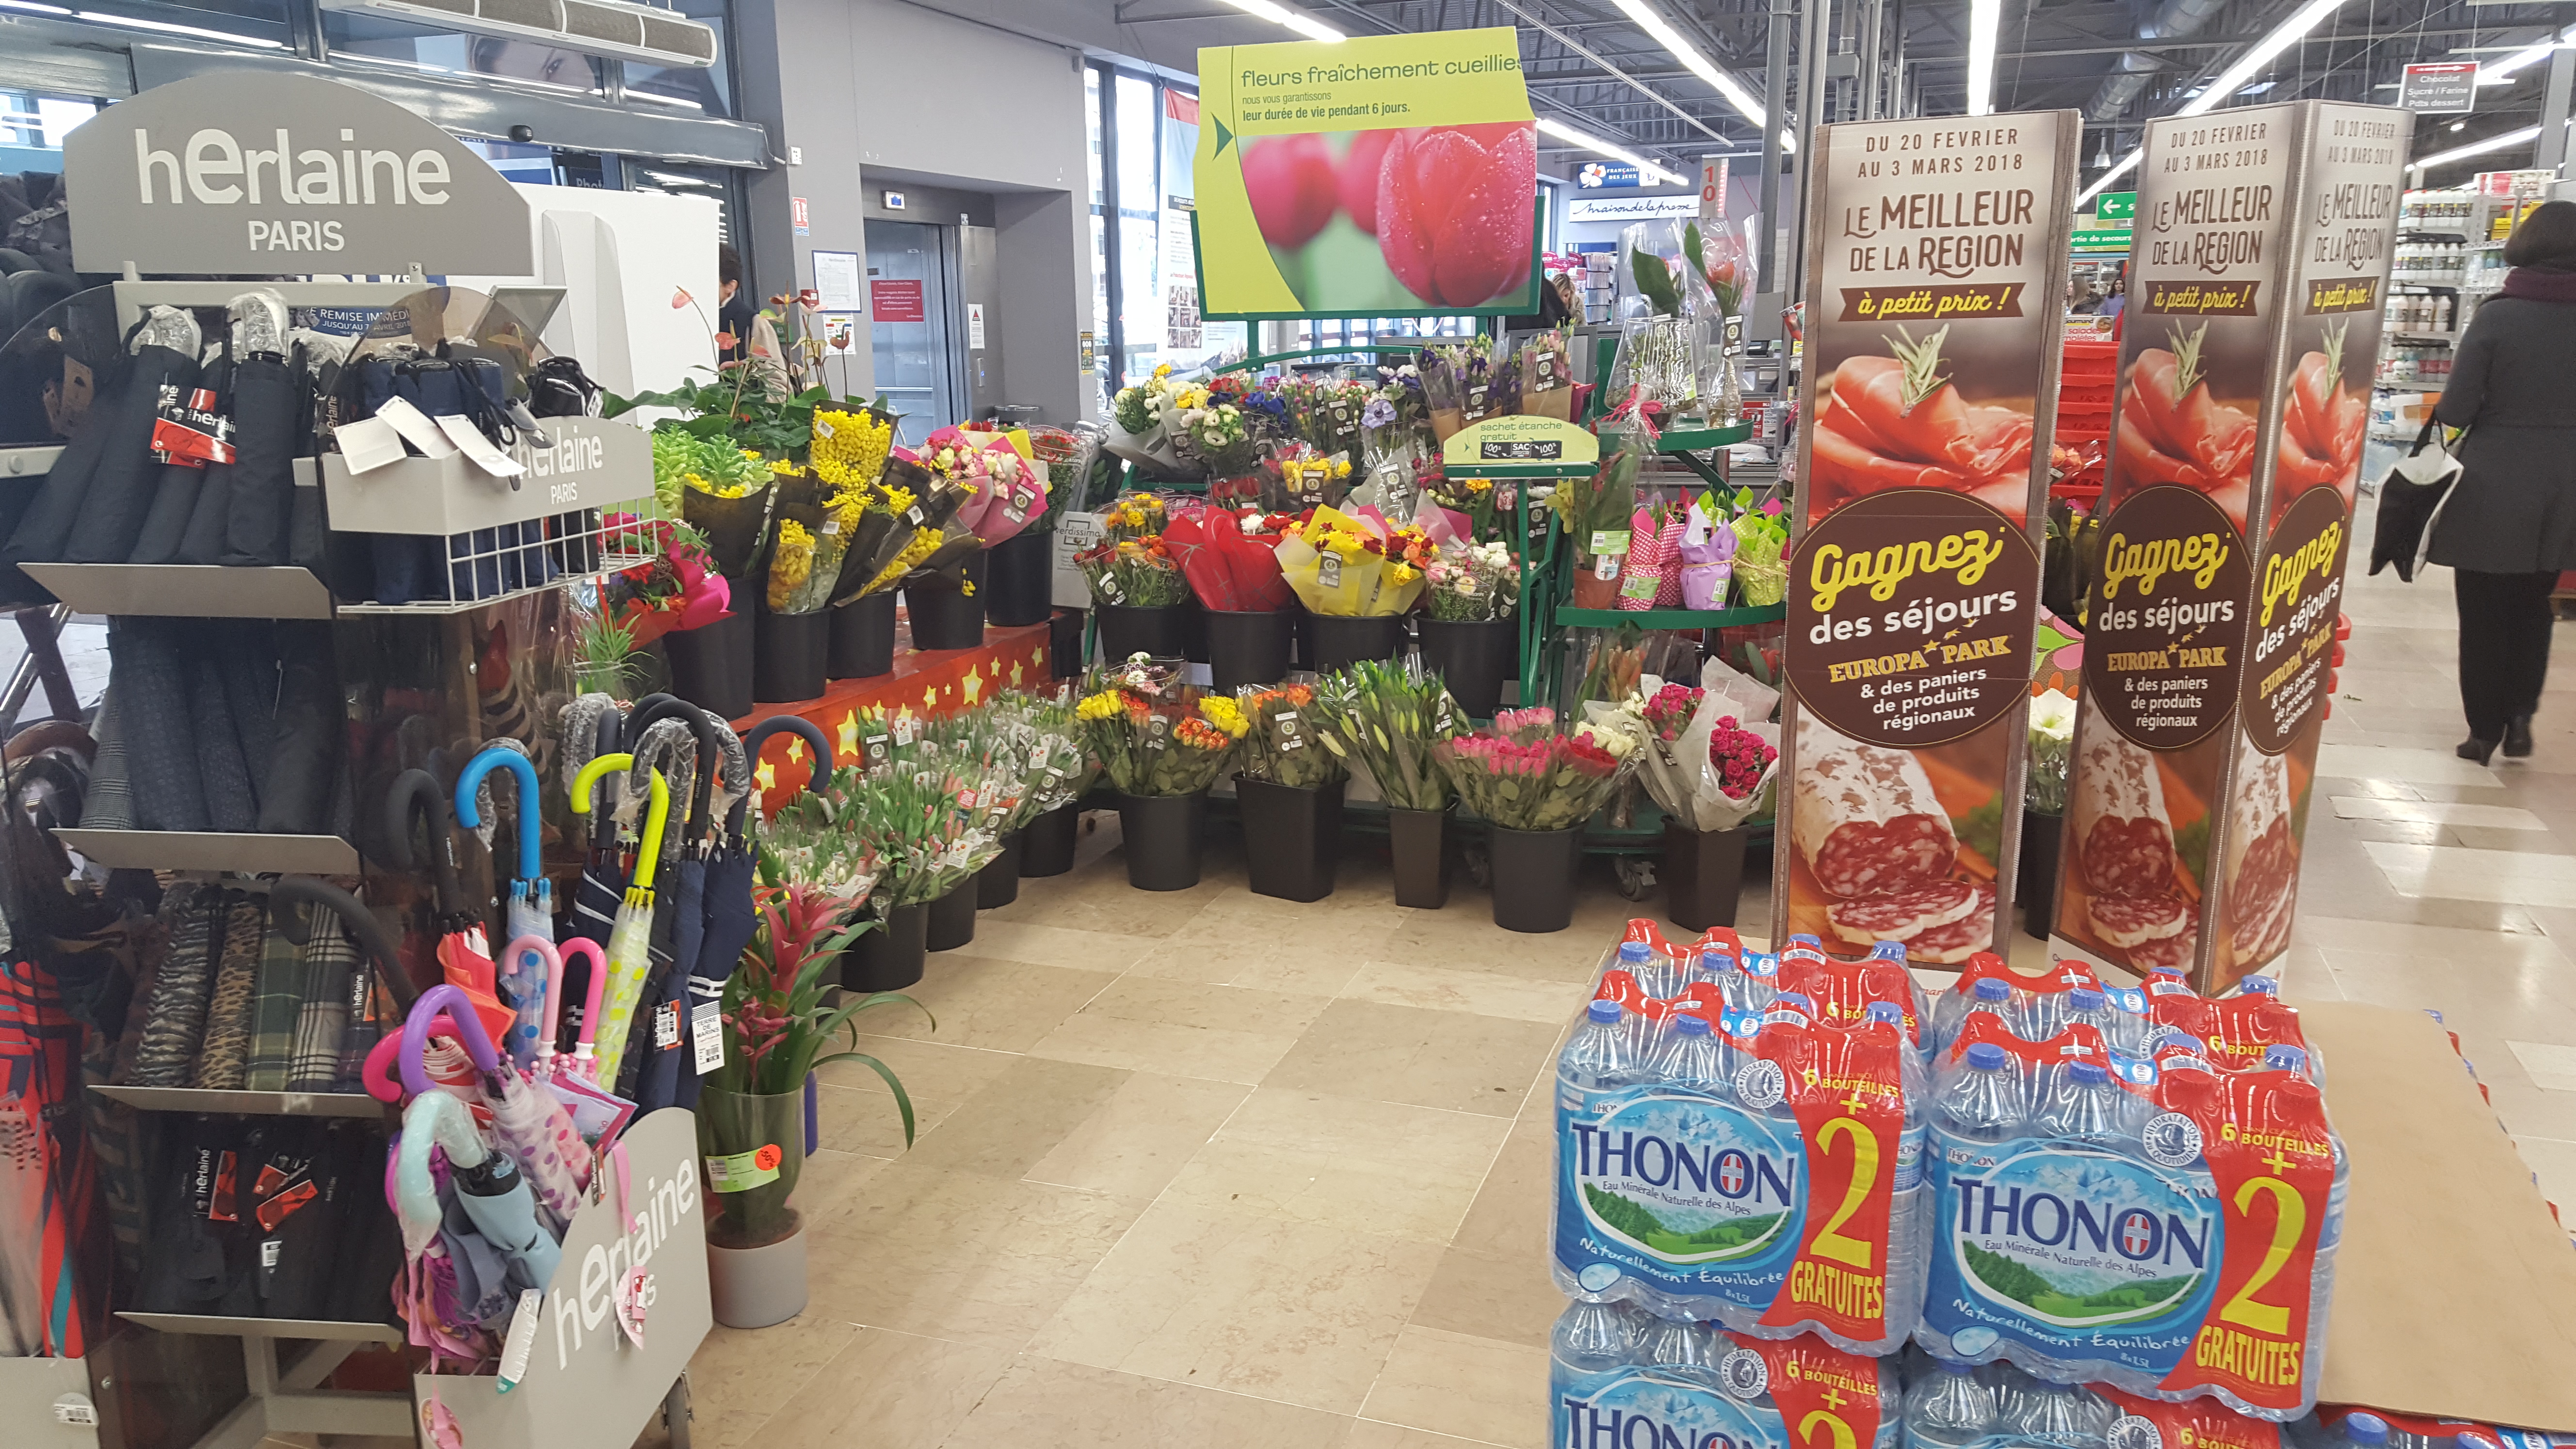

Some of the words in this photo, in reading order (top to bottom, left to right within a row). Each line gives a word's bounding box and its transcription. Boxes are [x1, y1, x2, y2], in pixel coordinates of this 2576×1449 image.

[1241, 71, 1302, 87] fleurs
[1307, 60, 1439, 83] fraîchement
[1242, 96, 1260, 105] nous
[1263, 95, 1280, 104] vous
[1283, 91, 1331, 104] garantissons
[2407, 88, 2433, 96] Sucre
[2441, 86, 2469, 95] Farine
[1243, 110, 1261, 121] leur
[1265, 107, 1293, 120] durée
[1296, 107, 1308, 118] de
[1310, 105, 1325, 118] vie
[1328, 104, 1369, 120] pendant
[1372, 103, 1378, 114] 6
[1381, 102, 1410, 116] jours.
[1866, 135, 1889, 152] DU
[1900, 134, 1921, 150] 20
[1933, 128, 2018, 148] FEVRIER
[2171, 131, 2186, 148] DU
[2191, 129, 2205, 146] 20
[2211, 123, 2267, 144] FEVRIER
[135, 128, 451, 204] herlaine
[1858, 161, 1880, 178] AU
[1891, 160, 1900, 176] 3
[1912, 157, 1963, 176] MARS
[1974, 154, 2023, 172] 2018
[2164, 157, 2179, 173] AU
[2184, 156, 2190, 172] 3
[2196, 152, 2229, 170] MARS
[2236, 149, 2268, 167] 2018
[1844, 207, 1877, 239] LE
[1881, 189, 2034, 230] MEILLEUR
[2152, 201, 2171, 233] LE
[2174, 185, 2272, 225] MEILLEUR
[2316, 193, 2331, 227] LE
[2333, 183, 2393, 219] MEILLEUR
[247, 221, 345, 251] PARIS
[2314, 236, 2326, 262] DE
[2329, 236, 2341, 262] LA
[2344, 228, 2385, 271] REGION
[1850, 247, 1877, 272] DE
[1884, 246, 1909, 271] LA
[1918, 233, 2024, 278] REGION
[2152, 241, 2170, 265] DE
[2172, 241, 2188, 265] LA
[2193, 230, 2263, 275] REGION
[1858, 291, 1876, 314] à
[1876, 290, 1933, 321] petit
[1934, 290, 1992, 319] prix
[2154, 284, 2165, 307] à
[2165, 286, 2200, 313] petit
[2199, 285, 2238, 314] prix
[2321, 283, 2346, 313] petit
[2343, 282, 2368, 311] prix
[321, 309, 363, 322] REMISE
[322, 320, 364, 330] JUSQU'AU
[1480, 433, 1517, 442] gratuit
[1481, 423, 1516, 431] sachet
[1518, 421, 1562, 430] étanche
[550, 482, 577, 504] PARIS
[1810, 614, 1872, 644] des
[1884, 590, 2016, 635] séjours
[2099, 602, 2138, 631] des
[2144, 597, 2235, 635] séjours
[2255, 625, 2285, 662] des
[2288, 577, 2340, 637] séjours
[1828, 650, 1929, 683] EUROPA
[1941, 635, 2012, 664] PARK
[2108, 650, 2171, 671] EUROPA
[2179, 646, 2227, 668] PARK
[2260, 650, 2302, 700] EUROPA
[2306, 621, 2332, 659] PARK
[1861, 684, 1874, 698] &
[1880, 679, 1913, 695] des
[1919, 668, 1987, 692] paniers
[2124, 677, 2134, 692] &
[2137, 676, 2158, 692] des
[2162, 676, 2208, 694] paniers
[1873, 699, 1896, 714] de
[1901, 687, 1980, 711] produits
[2131, 694, 2146, 709] de
[2149, 693, 2202, 712] produits
[1884, 705, 1975, 730] régionaux
[2136, 713, 2198, 731] régionaux
[353, 975, 364, 1006] herlaine
[696, 1016, 717, 1027] TERRE
[696, 1027, 719, 1038] MARINS
[1804, 1069, 1818, 1086] 6
[1822, 1079, 1899, 1098] BOUTEILLES
[2221, 1123, 2237, 1142] 6
[2240, 1132, 2329, 1158] BOUTEILLES
[196, 1149, 210, 1193] herlaine
[1572, 1123, 1794, 1207] THONON
[1603, 1181, 1618, 1190] Eau
[1621, 1181, 1658, 1199] Minérale
[1661, 1192, 1704, 1207] Naturelle
[1706, 1198, 1722, 1209] des
[1725, 1201, 1751, 1216] Alpes
[1810, 1117, 1879, 1269] 2
[1952, 1176, 2209, 1269] THONON
[1579, 1237, 1691, 1284] Naturellement
[1698, 1267, 1785, 1286] Équilibrée
[1985, 1240, 2002, 1250] Eau
[2004, 1240, 2049, 1259] Minérale
[2053, 1251, 2102, 1268] Naturelle
[2106, 1259, 2123, 1271] des
[2128, 1263, 2157, 1278] Alpes
[2220, 1176, 2306, 1336] 2
[1790, 1261, 1883, 1319] GRATUITES
[1953, 1299, 2082, 1348] Naturellement
[2091, 1330, 2190, 1350] Équilibrée
[2195, 1325, 2301, 1385] GRATUITES
[1786, 1360, 1800, 1378] 6
[1803, 1370, 1877, 1396] BOUTEILLES
